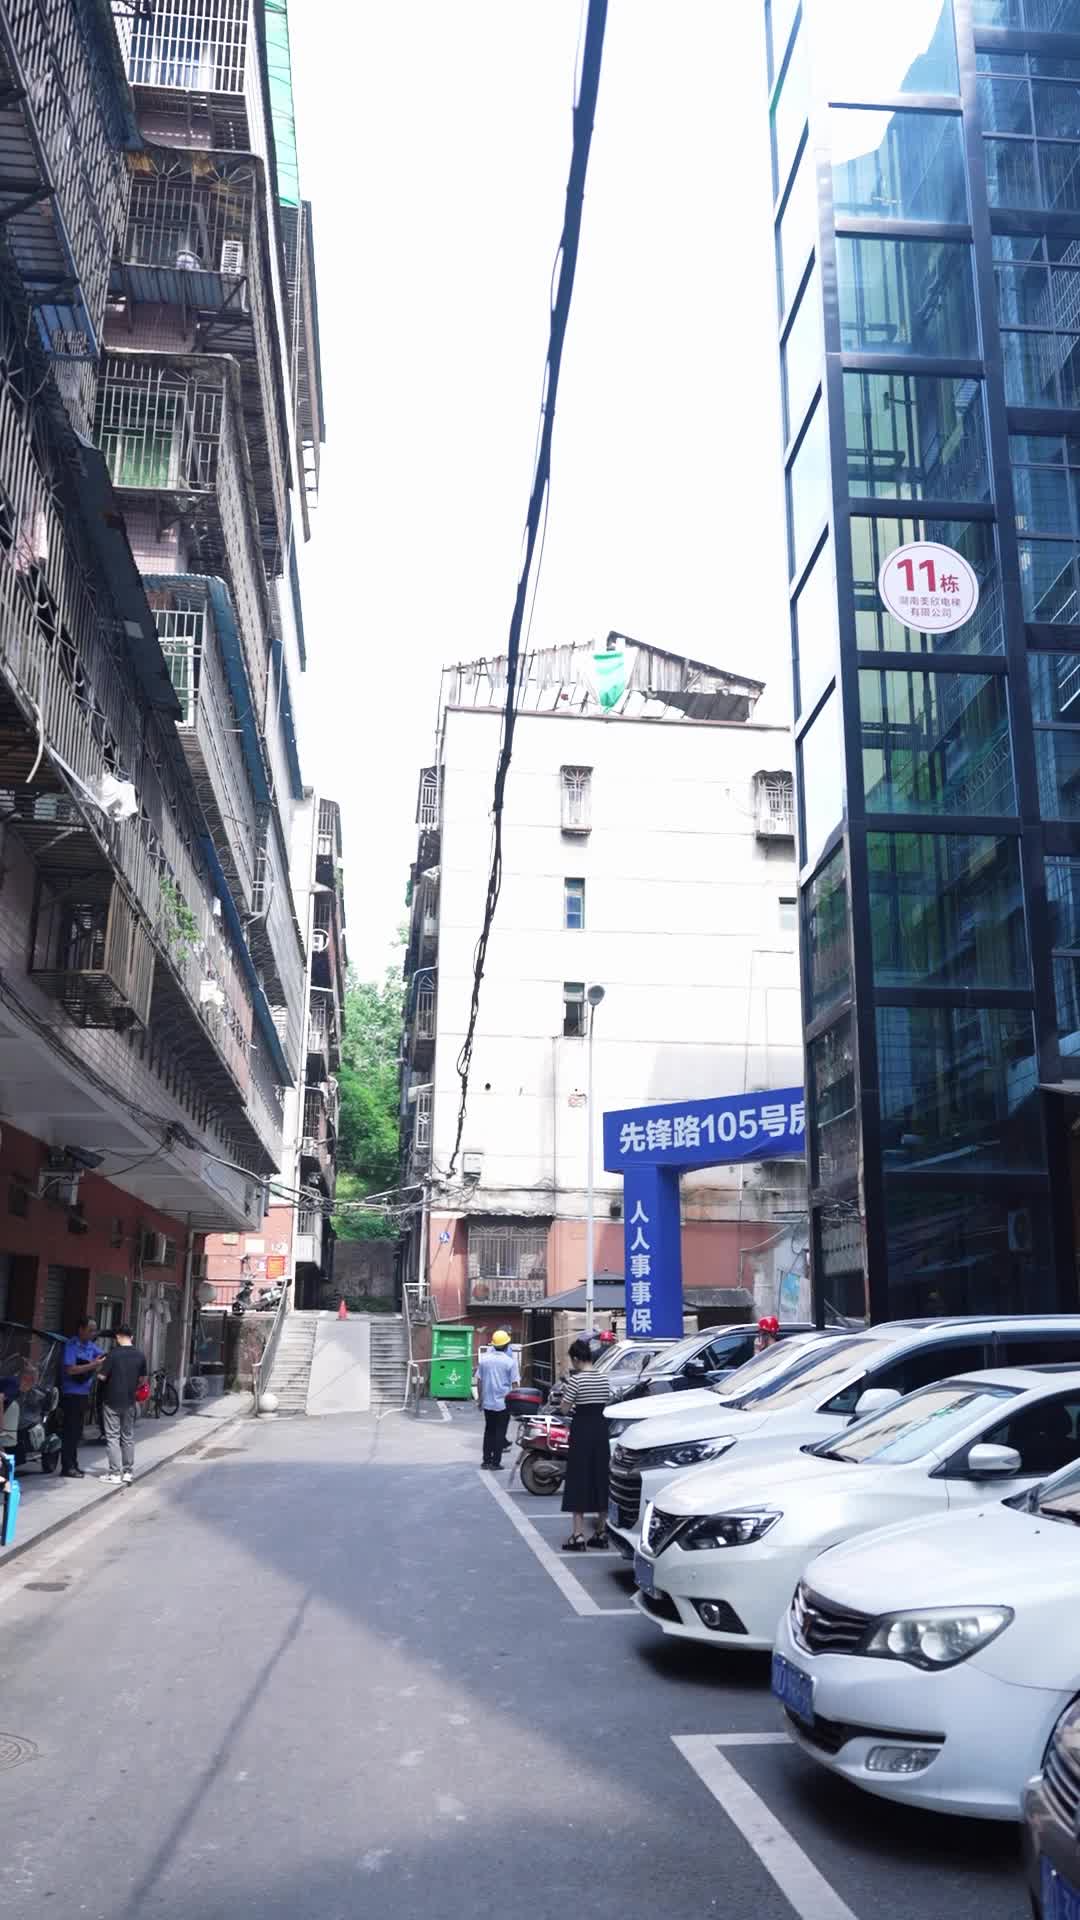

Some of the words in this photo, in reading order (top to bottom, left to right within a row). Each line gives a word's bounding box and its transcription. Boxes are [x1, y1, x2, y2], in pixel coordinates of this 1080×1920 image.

[896, 558, 960, 593] 11栋
[911, 608, 952, 618] 有限公司
[629, 1200, 652, 1333] 人人事事保
